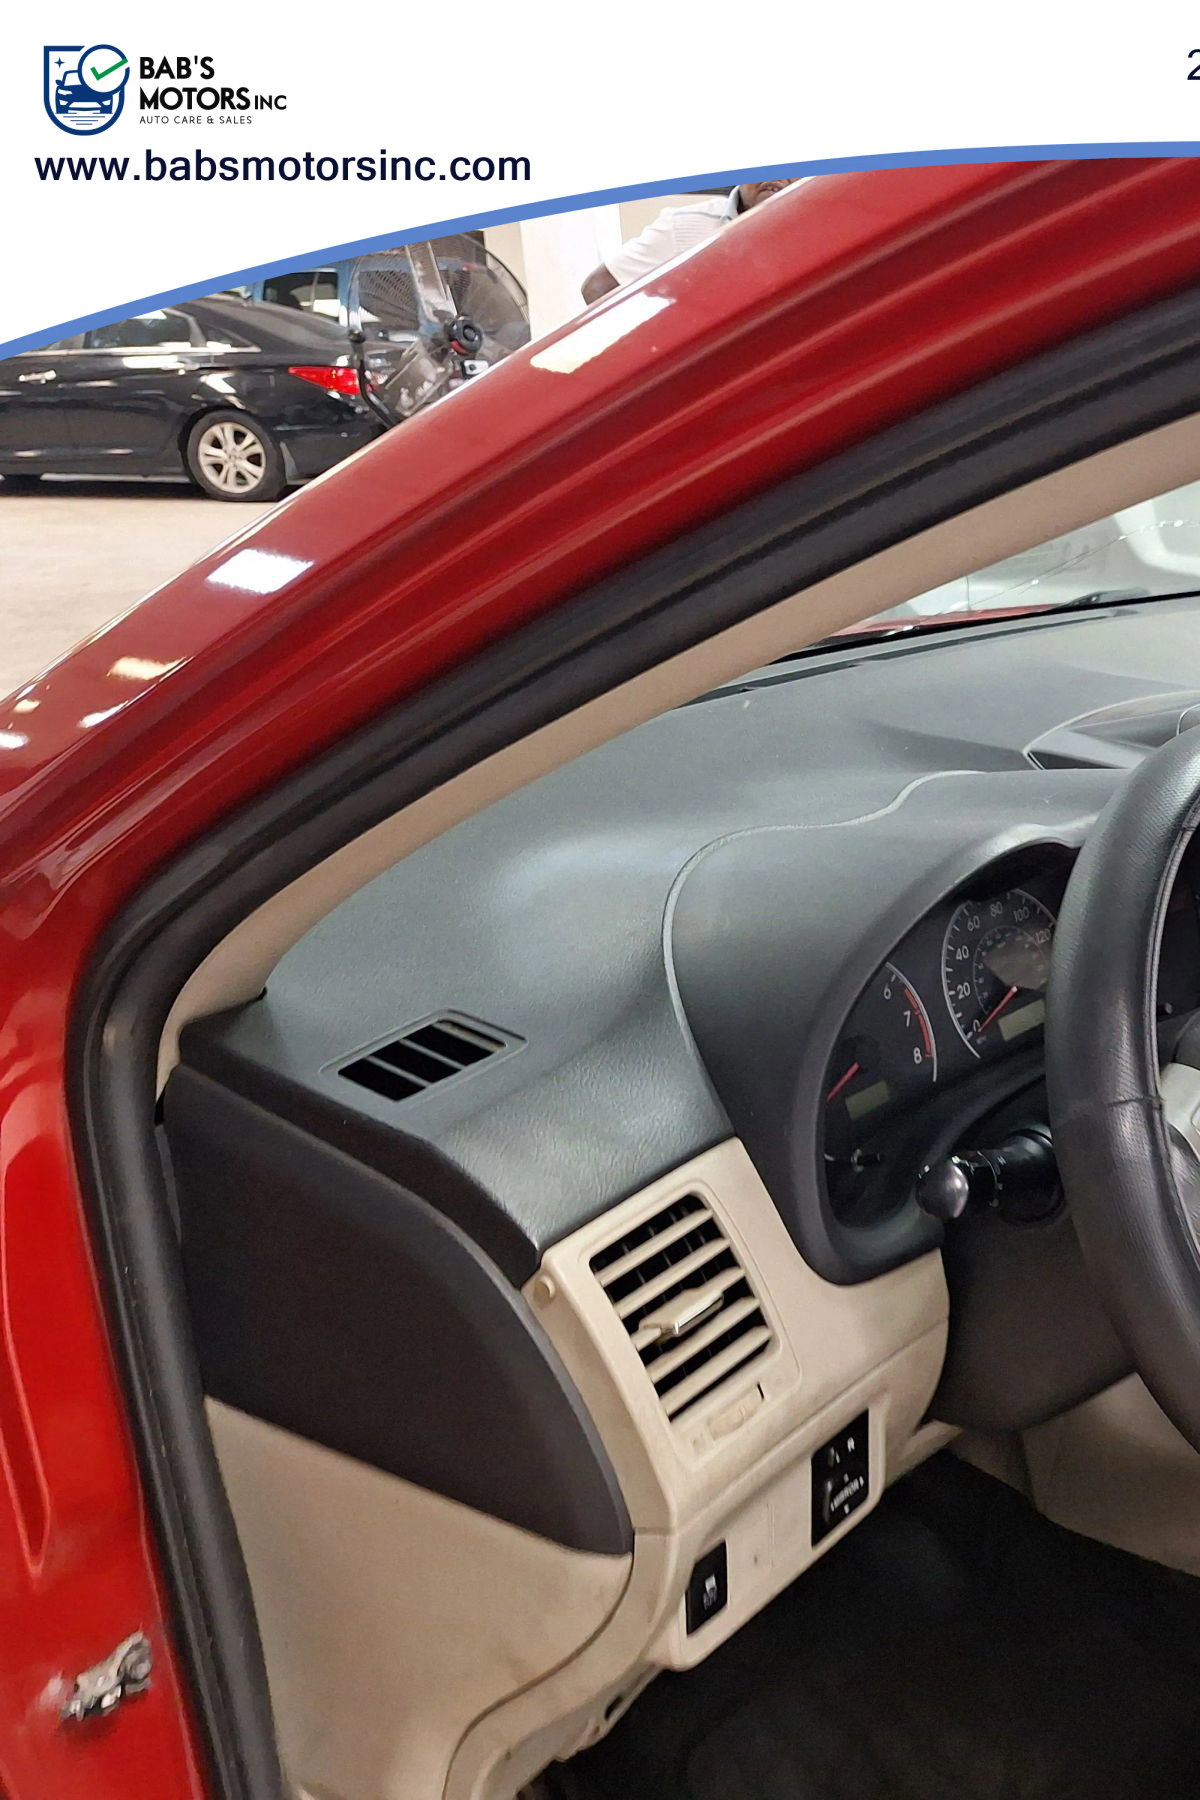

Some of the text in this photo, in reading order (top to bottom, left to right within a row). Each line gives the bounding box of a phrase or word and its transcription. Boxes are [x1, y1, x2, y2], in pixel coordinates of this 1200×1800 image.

[1013, 907, 1030, 922] 100
[967, 916, 981, 931] 60
[1035, 928, 1052, 945] 120
[956, 945, 970, 960] 40
[883, 984, 892, 1000] 6
[957, 982, 971, 999] 20
[903, 1010, 911, 1027] 7
[913, 1047, 922, 1064] 8
